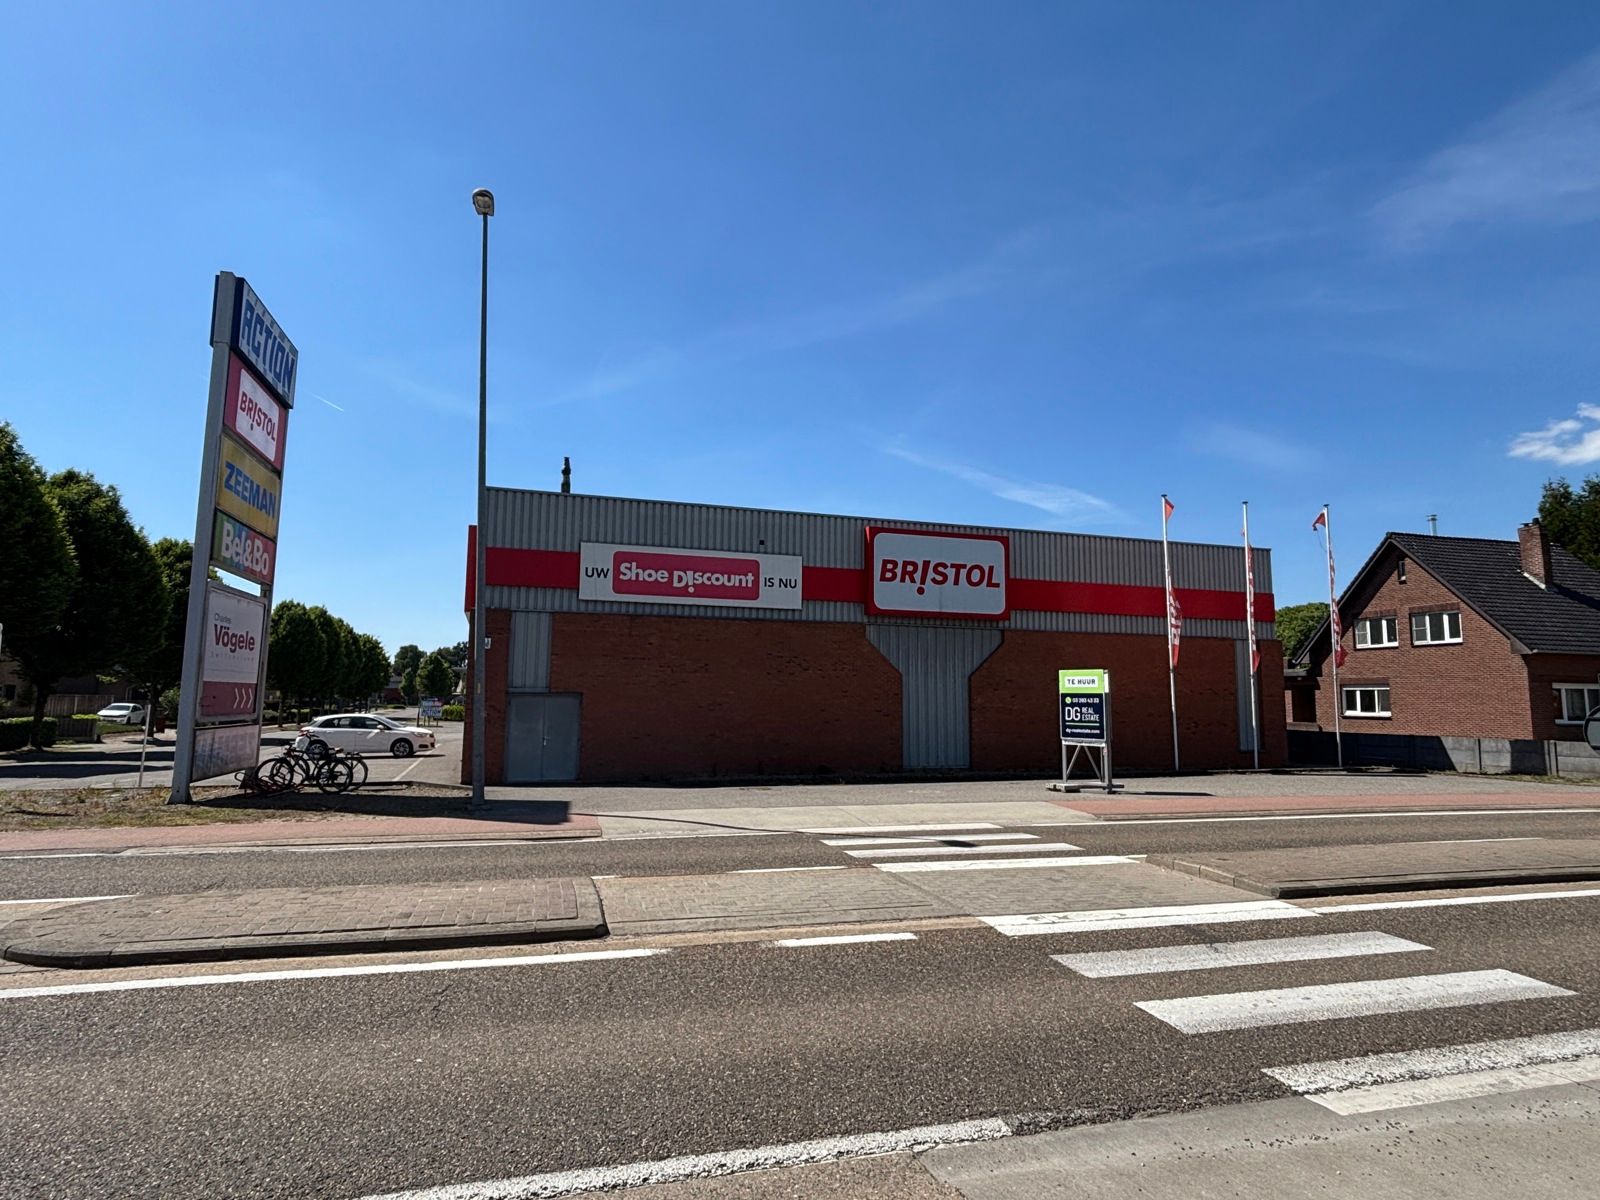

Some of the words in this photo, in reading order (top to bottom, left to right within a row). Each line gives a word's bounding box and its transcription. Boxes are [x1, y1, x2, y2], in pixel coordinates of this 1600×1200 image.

[242, 299, 294, 393] ACTION
[224, 461, 277, 519] ZEEMAN
[221, 521, 270, 576] Bel&Bo
[584, 566, 610, 579] UW
[619, 562, 669, 583] Shoe
[763, 576, 775, 588] IS
[778, 577, 798, 589] NU
[214, 623, 255, 653] Vögele
[1065, 707, 1081, 720] DG
